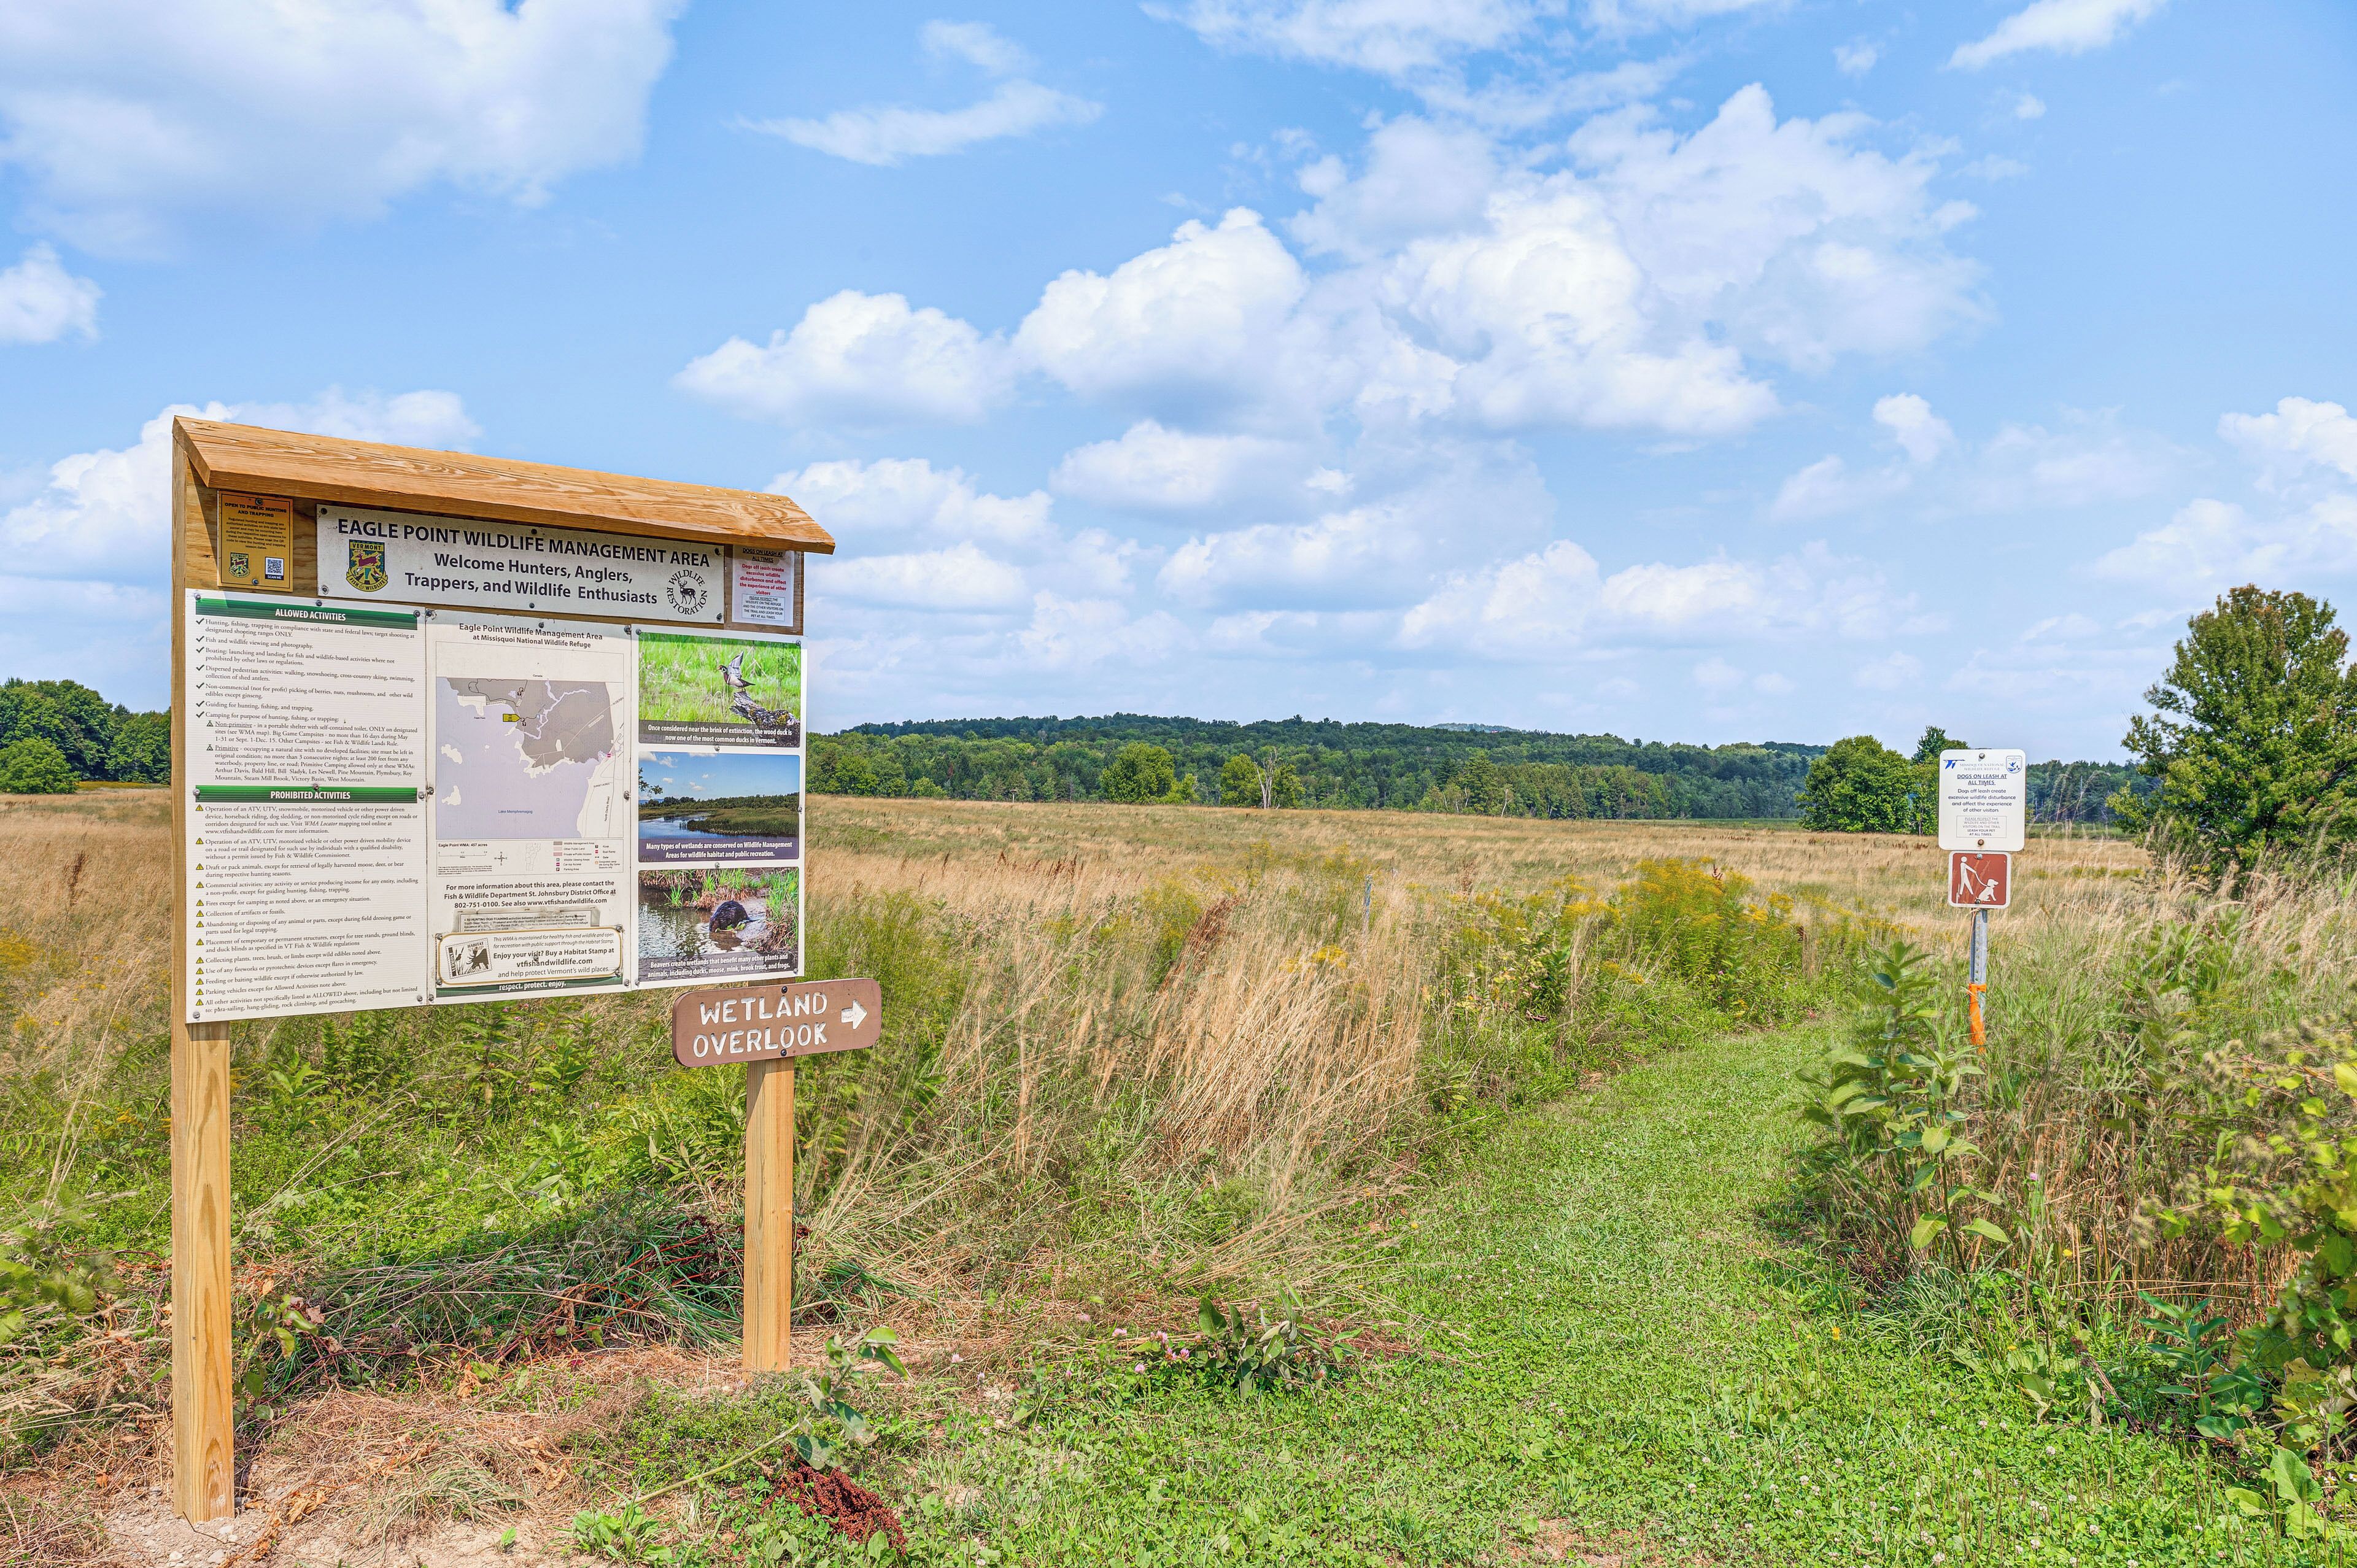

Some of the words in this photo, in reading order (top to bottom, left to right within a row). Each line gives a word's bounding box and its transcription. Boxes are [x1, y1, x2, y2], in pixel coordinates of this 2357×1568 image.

[338, 518, 398, 538] EAGLE
[404, 525, 460, 543] POINT
[463, 530, 543, 551] WILDLIFE
[549, 539, 666, 562] MANAGEMENT
[670, 551, 711, 567] AREA
[434, 553, 504, 571] Welcome
[509, 559, 570, 578] Hunters,
[575, 565, 632, 584] Anglers,
[668, 570, 705, 586] WILDLIFE
[349, 577, 359, 587] FISH
[365, 579, 385, 590] WILDLIFE
[404, 572, 478, 592] Trappers,
[483, 580, 511, 593] and
[514, 581, 570, 597] Wildlife
[578, 586, 657, 603] Enthusiasts
[667, 587, 707, 615] RESTORATION
[275, 609, 308, 618] ALLOWED
[309, 611, 346, 620] ACTIVITIES
[459, 623, 481, 632] Eagle
[504, 626, 533, 635] Wildlife
[535, 628, 584, 638] Management
[516, 958, 592, 968] vtfishandwildlife.com
[524, 981, 547, 990] protect.
[700, 992, 828, 1025] WETLAND
[692, 1021, 827, 1057] OVERLOOK
